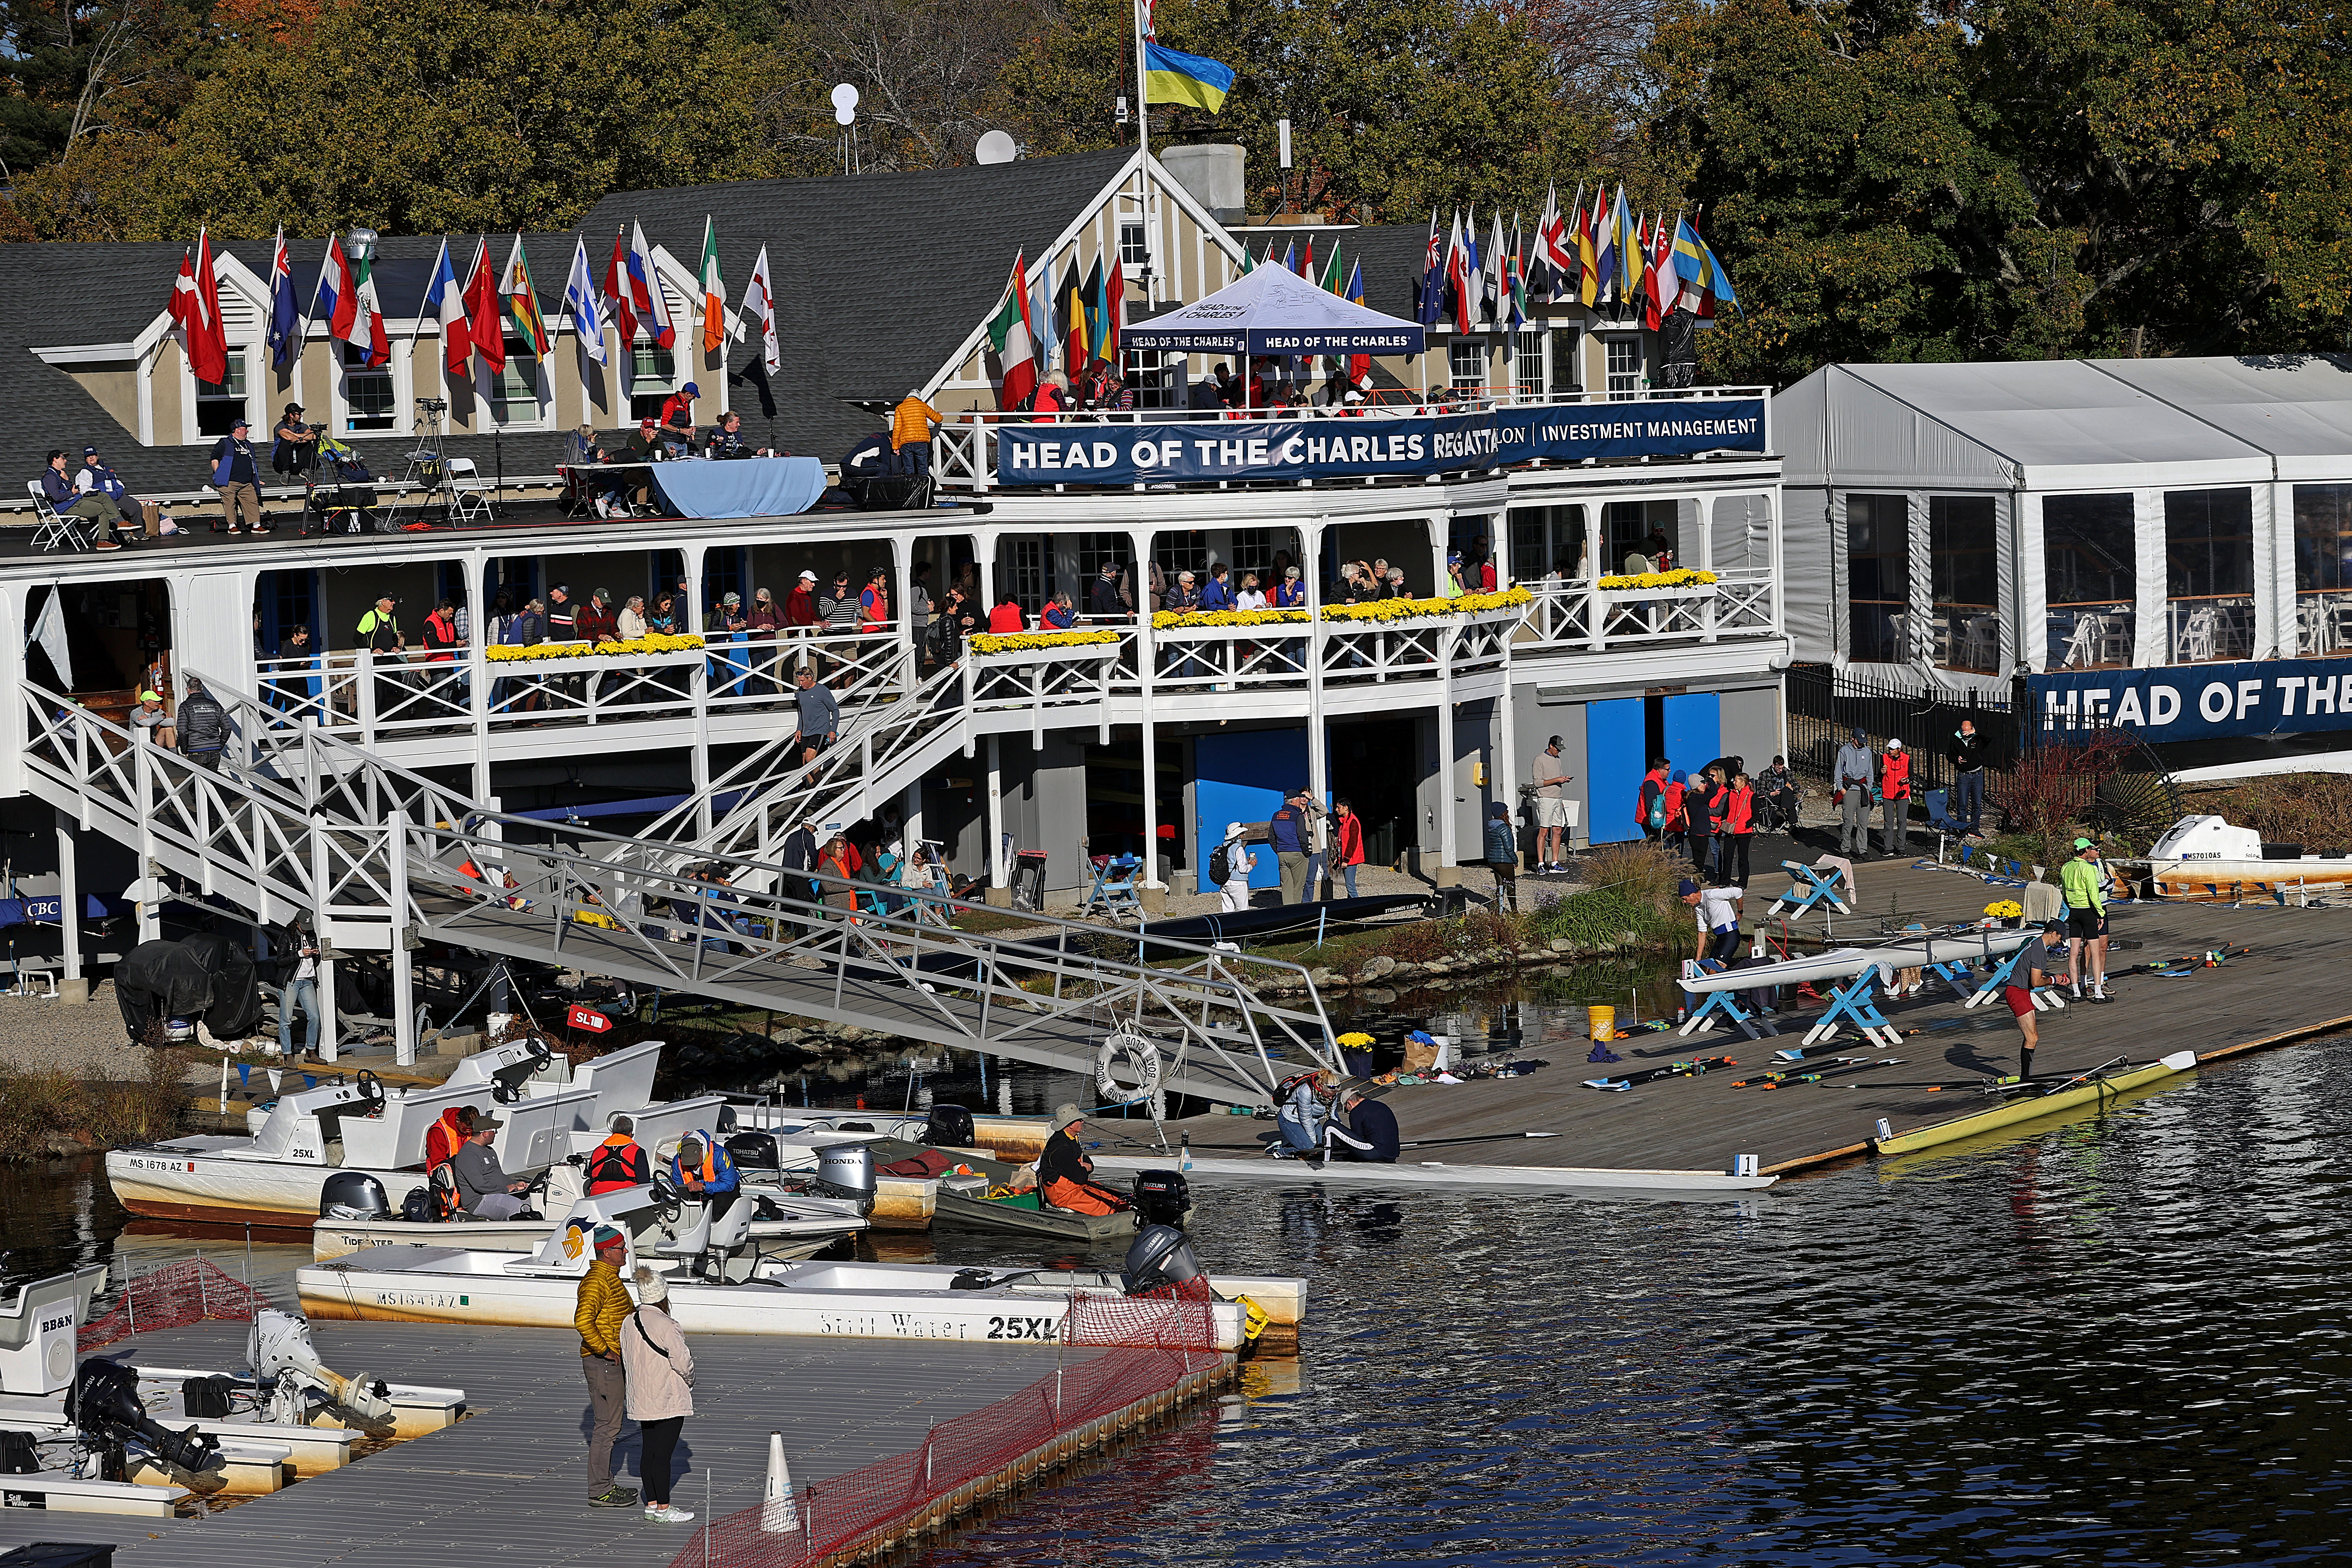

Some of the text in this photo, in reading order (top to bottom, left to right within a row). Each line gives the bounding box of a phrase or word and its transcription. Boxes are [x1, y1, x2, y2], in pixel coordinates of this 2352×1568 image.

[1132, 337, 1156, 346] HEAD
[1159, 337, 1171, 346] OF
[1173, 337, 1191, 346] THE
[1266, 337, 1300, 348] HEAD
[1304, 337, 1320, 347] OF
[1324, 337, 1348, 346] THE
[1542, 422, 1643, 441] INVESTMENT
[1648, 418, 1758, 437] MANAGEMENT
[1013, 442, 1118, 469] HEAD
[1131, 440, 1182, 468] OF
[1195, 438, 1268, 466] THE
[1434, 429, 1498, 459] REGATTA
[2043, 686, 2181, 731] HEAD
[2199, 679, 2263, 723] OF
[27, 901, 58, 917] CBC
[1687, 962, 1691, 975] 2
[1126, 1036, 1145, 1050] CLUB
[1146, 1057, 1157, 1078] BOAT
[931, 1117, 947, 1127] TOHATSU
[1880, 1120, 1890, 1136] 17
[293, 1148, 315, 1159] 25XL
[130, 1158, 182, 1171] MS 1678 AZ
[1745, 1156, 1751, 1172] 1
[1009, 1214, 1044, 1225] STARCRAFT
[341, 1236, 393, 1246] TIDEATER
[1147, 1232, 1163, 1249] YAMAHA
[42, 1314, 73, 1333] BB&N
[820, 1313, 967, 1339] Still Water
[986, 1317, 1058, 1341] 25XL
[78, 1375, 95, 1402] TOHATSU
